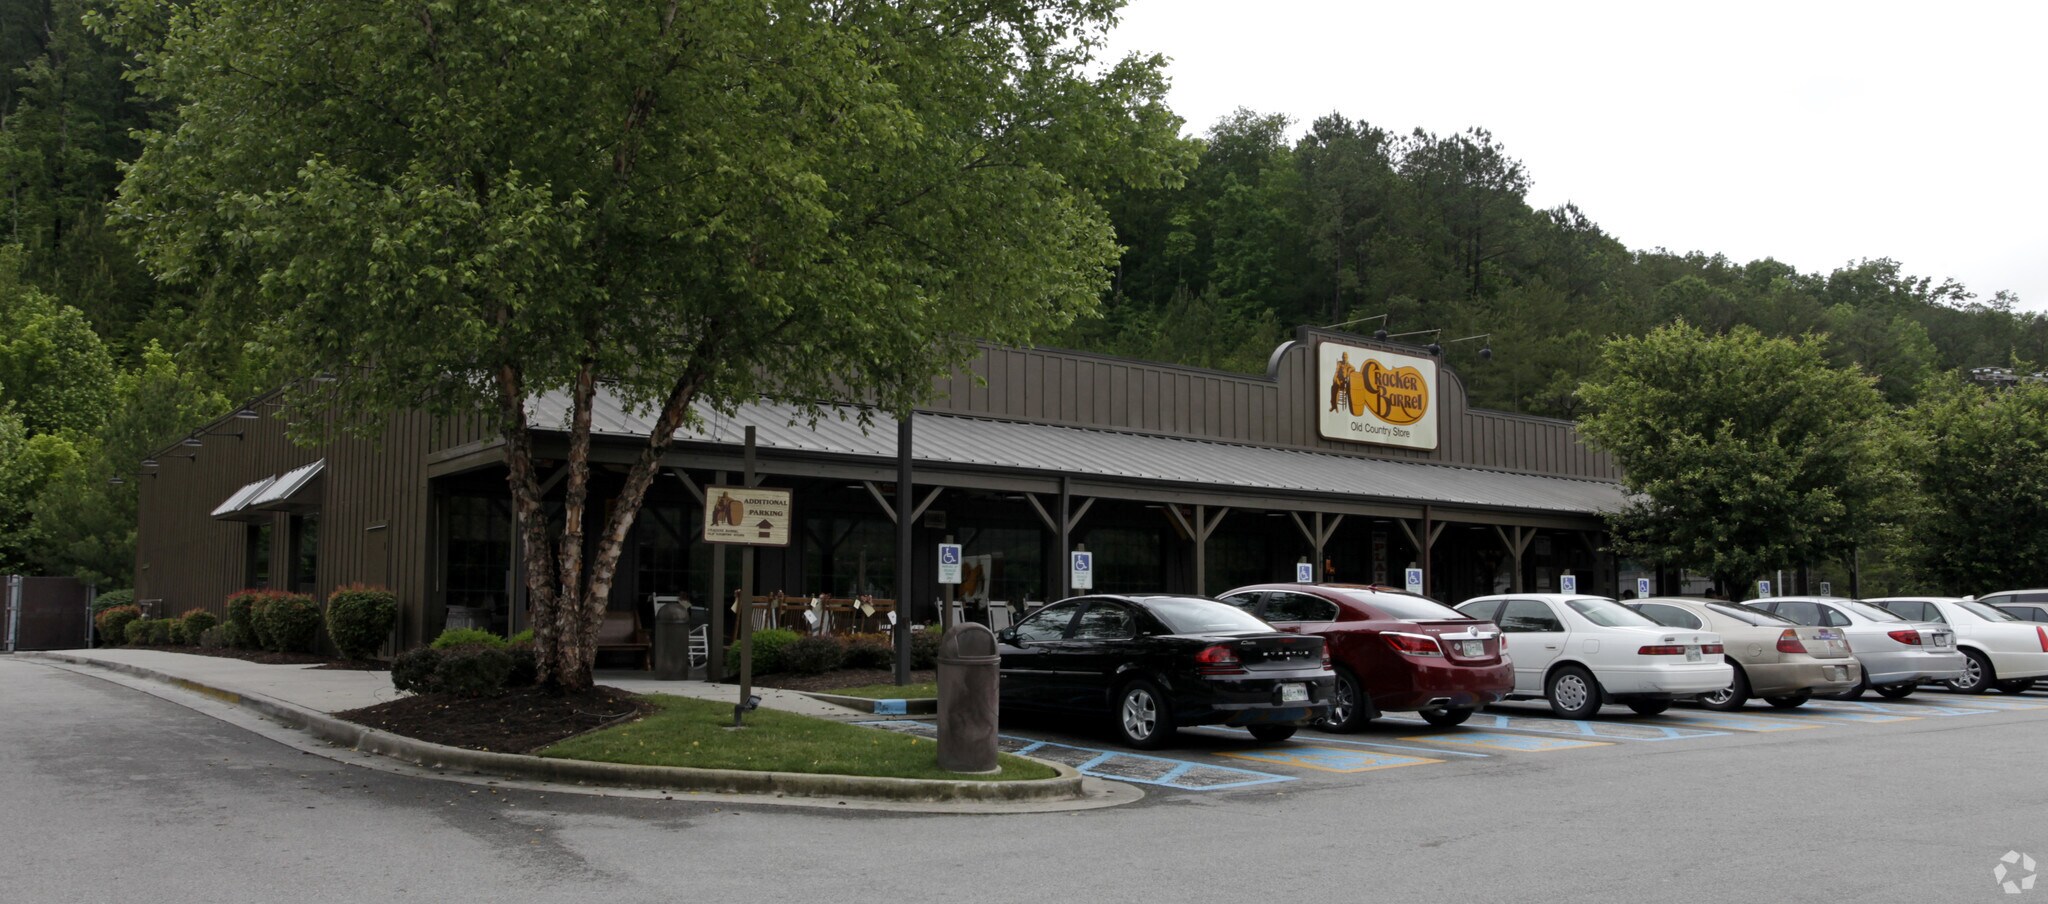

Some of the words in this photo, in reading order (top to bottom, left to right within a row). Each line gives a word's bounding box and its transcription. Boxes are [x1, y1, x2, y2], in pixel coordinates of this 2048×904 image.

[1350, 421, 1363, 432] Old
[1364, 423, 1392, 437] Country
[1392, 427, 1411, 438] Store
[743, 498, 788, 506] ADDITIONAL
[749, 509, 783, 517] PARKING
